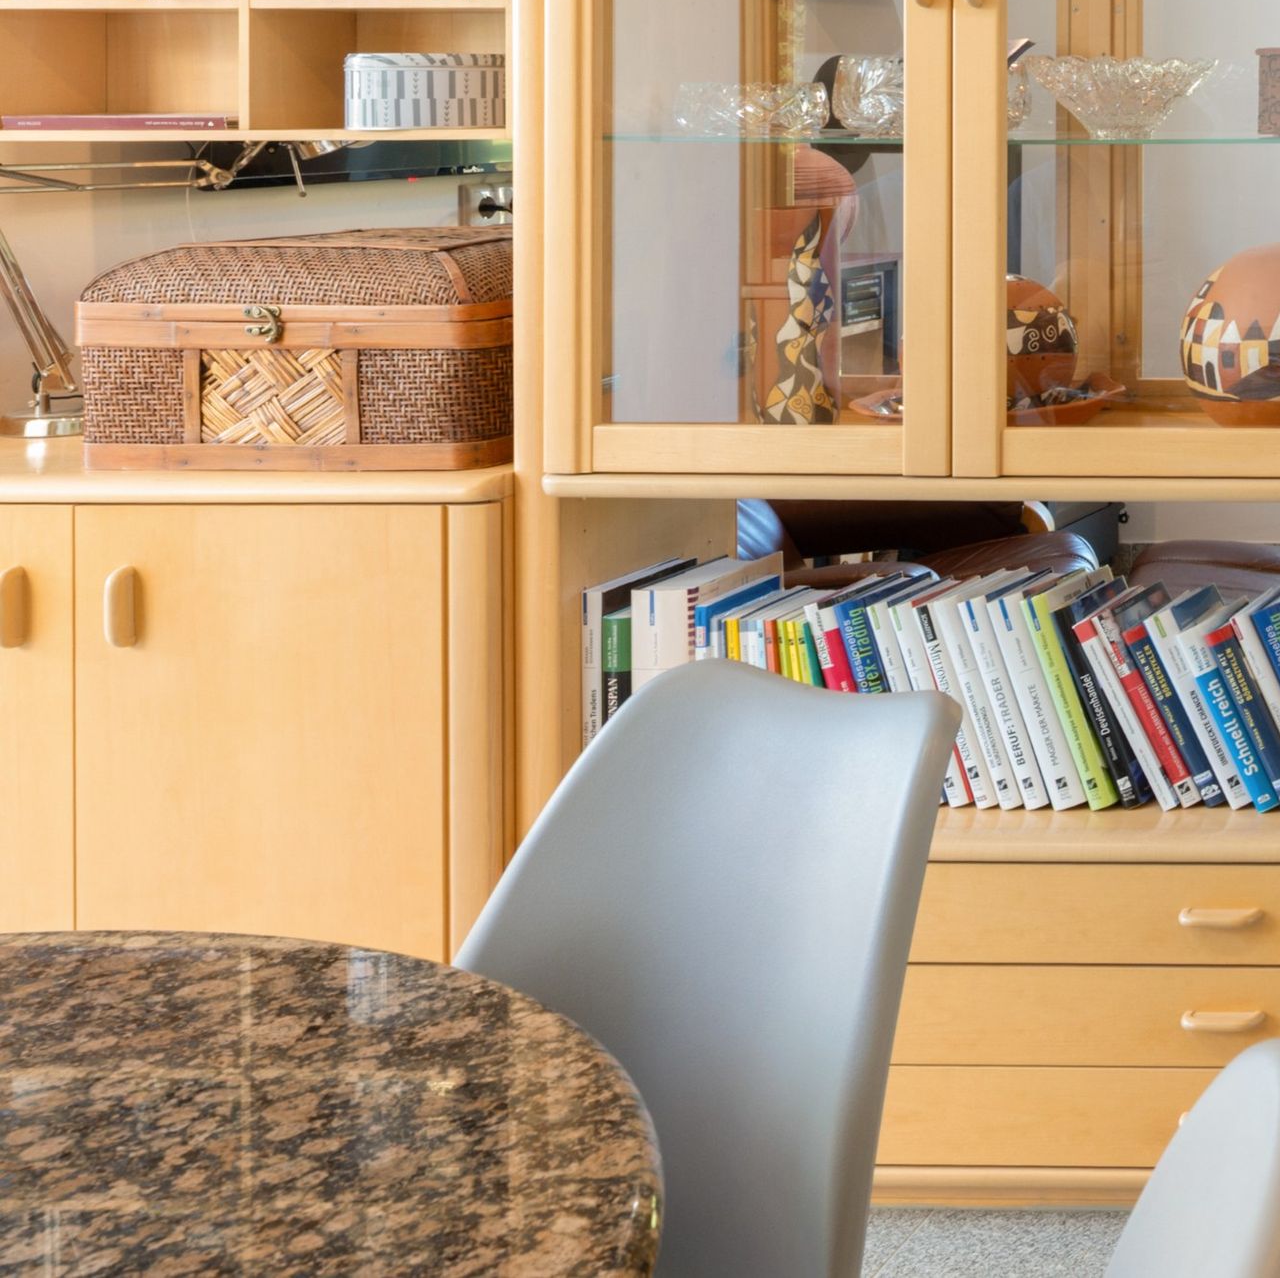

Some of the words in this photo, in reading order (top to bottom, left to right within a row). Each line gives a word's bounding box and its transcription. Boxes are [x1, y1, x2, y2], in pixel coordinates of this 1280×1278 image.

[816, 634, 830, 666] BÖRSE
[1136, 649, 1146, 665] MIT
[1190, 645, 1205, 672] Michael
[1217, 652, 1228, 667] MIT
[928, 642, 951, 693] MILLIONEN
[1141, 664, 1164, 701] GEWINNEN
[1143, 644, 1172, 698] BÖRSENZYKLEN
[1225, 646, 1253, 701] BÖRSENZYKLEN
[991, 677, 1014, 724] TRADER
[1027, 684, 1045, 718] MÄRKTE
[1054, 673, 1070, 709] Candlesticks
[1207, 678, 1233, 717] reich
[1224, 667, 1244, 705] GEWINNEN
[589, 690, 598, 718] Tradens
[1065, 709, 1073, 720] mit
[1080, 673, 1110, 736] Devisenhandel
[1162, 704, 1175, 723] Müller
[1190, 689, 1208, 720] CHANCEN
[1243, 707, 1256, 728] Müller
[1037, 718, 1049, 734] DER
[1068, 719, 1081, 742] Analyse
[1150, 709, 1166, 735] WARREN
[1172, 724, 1185, 746] Thomas
[1006, 724, 1026, 766] BERUF:
[1044, 735, 1060, 767] MAGIER
[1203, 720, 1228, 767] UNENTDECKTE
[1224, 717, 1258, 776] Schnell
[1252, 727, 1265, 751] Thomas
[1077, 742, 1089, 773] Technische
